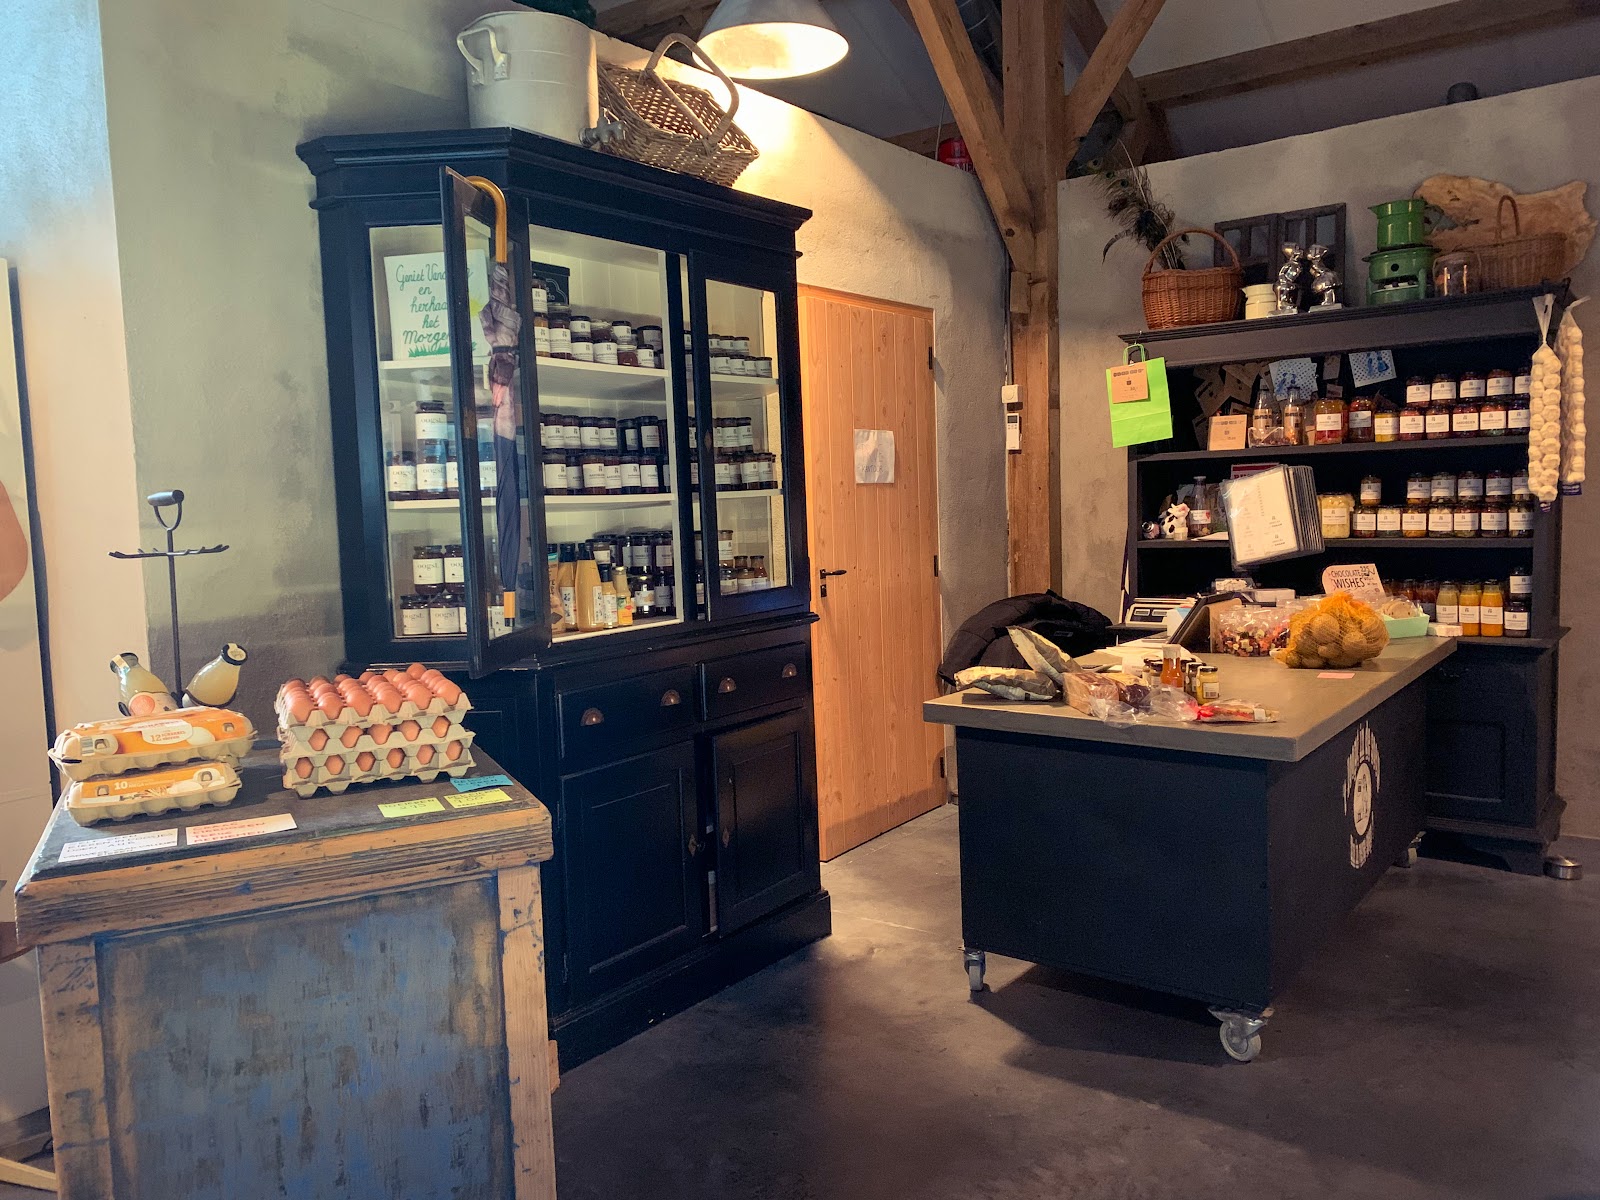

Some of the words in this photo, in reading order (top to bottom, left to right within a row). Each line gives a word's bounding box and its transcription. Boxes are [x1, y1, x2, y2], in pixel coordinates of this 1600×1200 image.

[396, 264, 425, 291] Geniet
[418, 286, 433, 295] en
[410, 296, 449, 313] herhaa
[422, 314, 440, 328] het
[403, 330, 450, 352] Morge
[417, 562, 439, 570] oogst
[1331, 570, 1361, 578] CHOCOLATE
[1334, 577, 1366, 589] WISHES
[114, 781, 128, 790] 10
